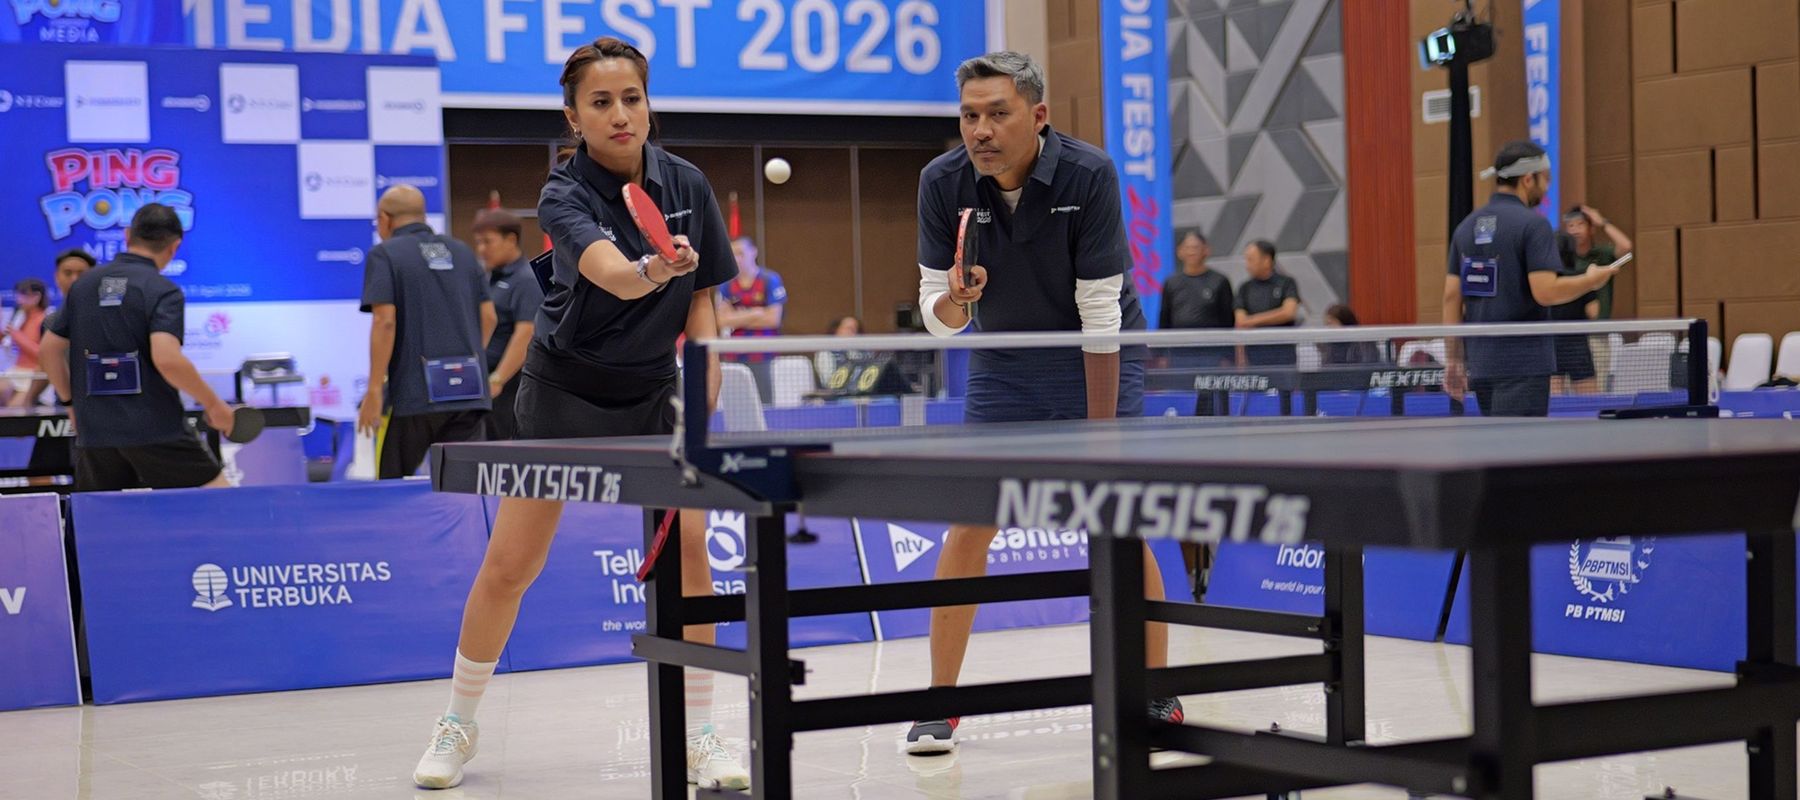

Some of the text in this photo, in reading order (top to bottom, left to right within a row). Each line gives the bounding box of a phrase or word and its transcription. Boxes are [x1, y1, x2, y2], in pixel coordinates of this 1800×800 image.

[486, 0, 712, 68] FEST
[736, 0, 942, 75] 2026
[1524, 22, 1550, 146] FEST
[1121, 72, 1155, 182] FEST
[47, 148, 179, 193] PING
[39, 188, 194, 240] PONG
[1127, 184, 1164, 296] 2026
[894, 538, 923, 554] ntv
[232, 561, 392, 587] UNIVERSITAS
[1583, 560, 1629, 575] PBPTMSI
[235, 585, 353, 608] TERBUKA
[1565, 604, 1625, 623] PB PTMSI
[602, 620, 647, 632] the wor
